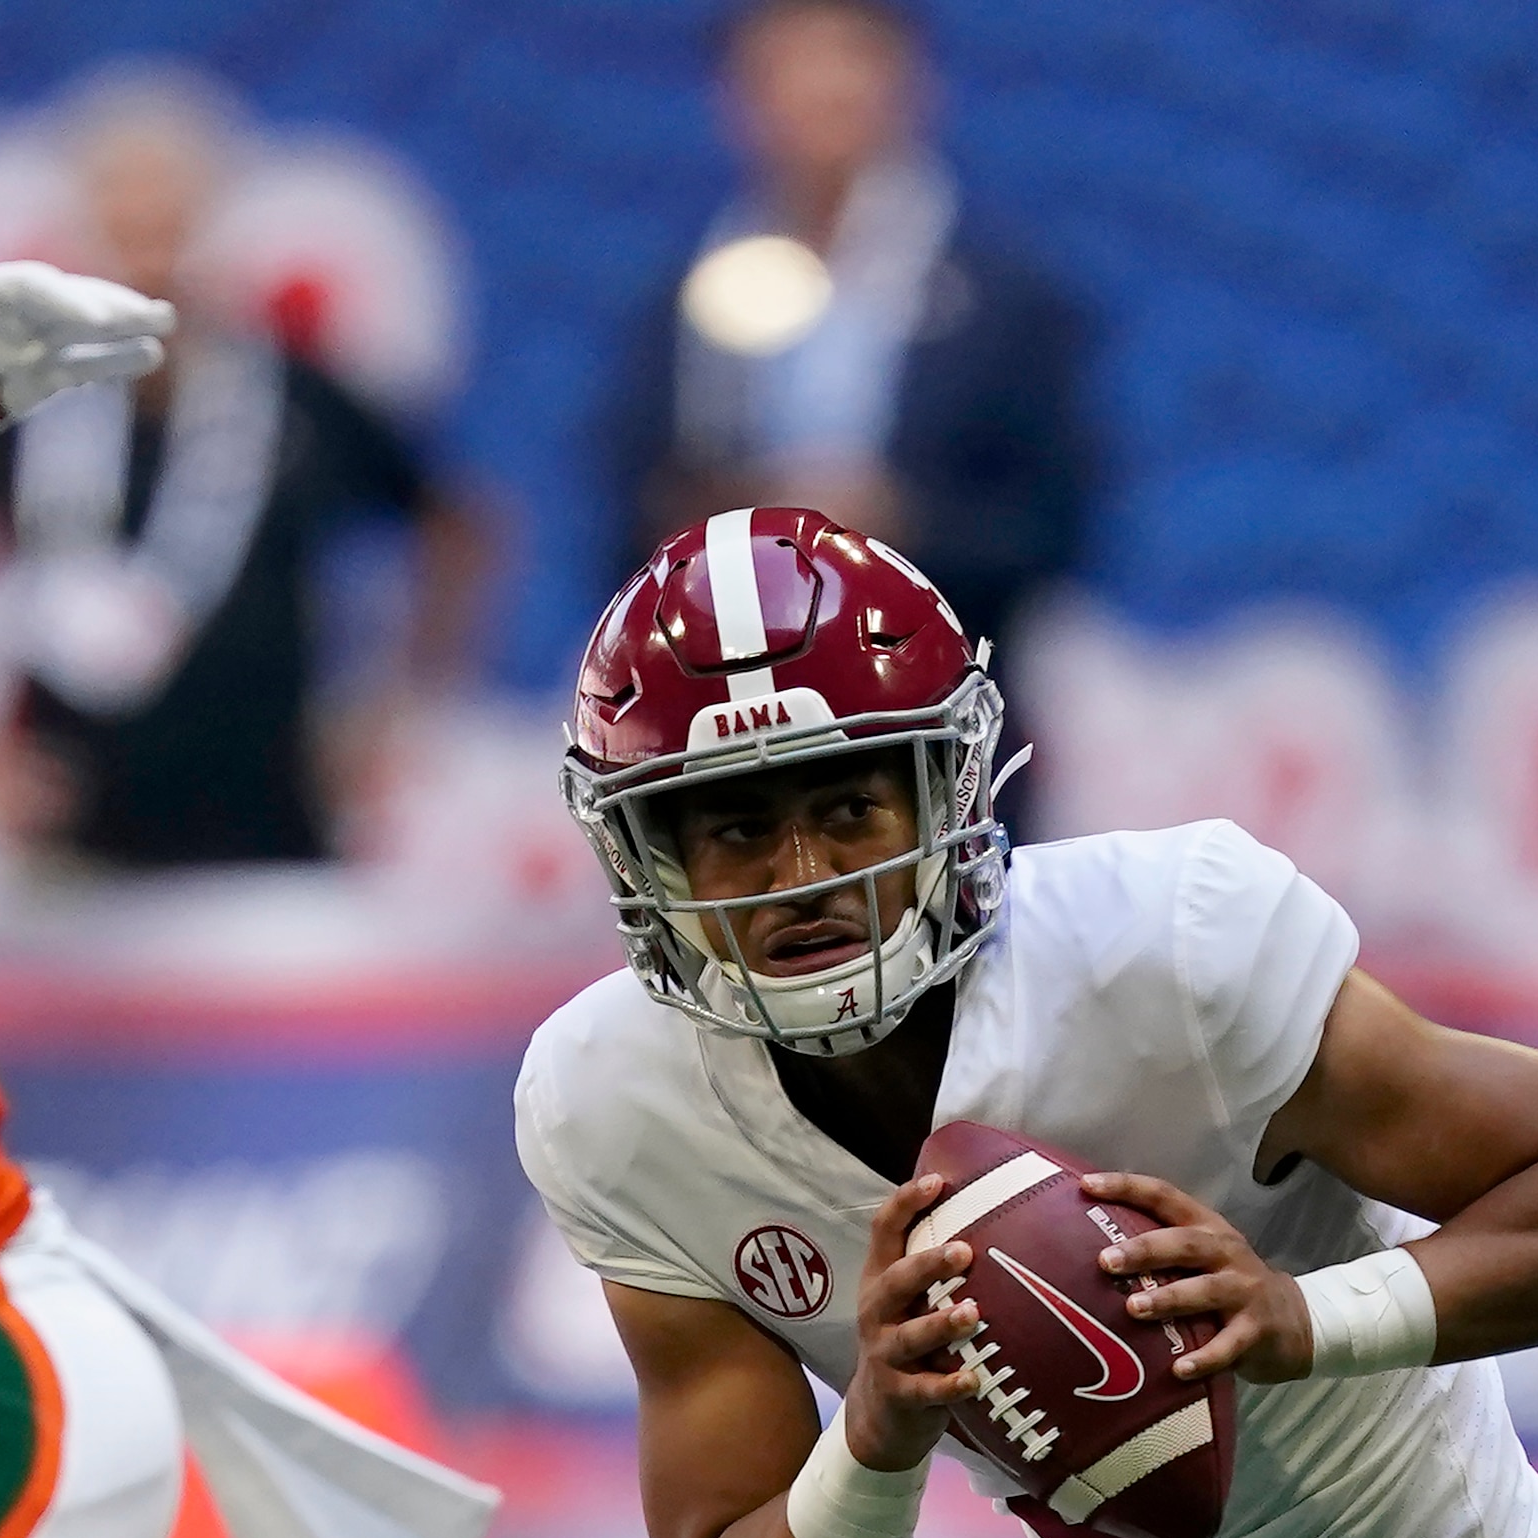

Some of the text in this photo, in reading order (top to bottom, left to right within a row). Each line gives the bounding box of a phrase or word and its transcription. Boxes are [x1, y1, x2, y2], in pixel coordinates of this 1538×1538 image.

[714, 701, 792, 737] BAMA
[829, 986, 859, 1024] A
[741, 1230, 824, 1313] SEC
